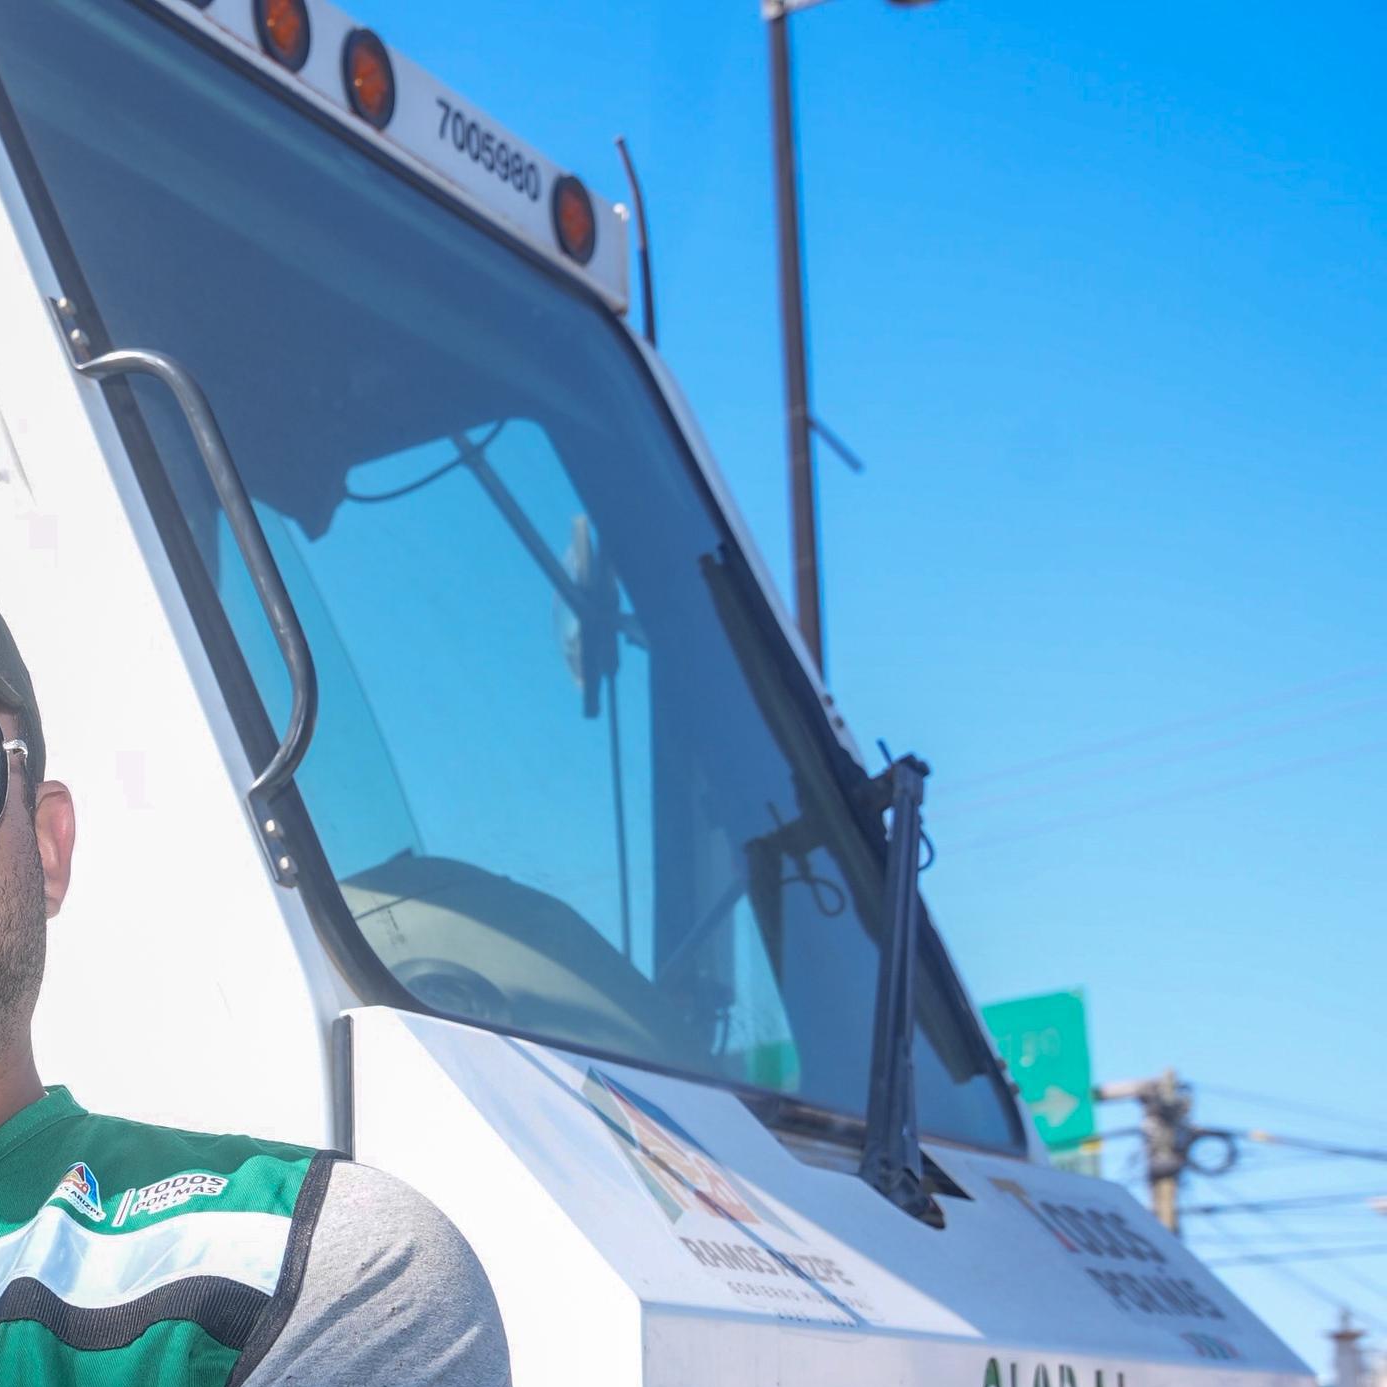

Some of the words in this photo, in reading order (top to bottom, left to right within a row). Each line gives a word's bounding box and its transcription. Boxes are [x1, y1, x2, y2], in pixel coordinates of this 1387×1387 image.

[435, 97, 541, 202] 7005980
[134, 1192, 170, 1212] POR
[142, 1175, 225, 1199] TODOS
[679, 1236, 779, 1275] RAMOS
